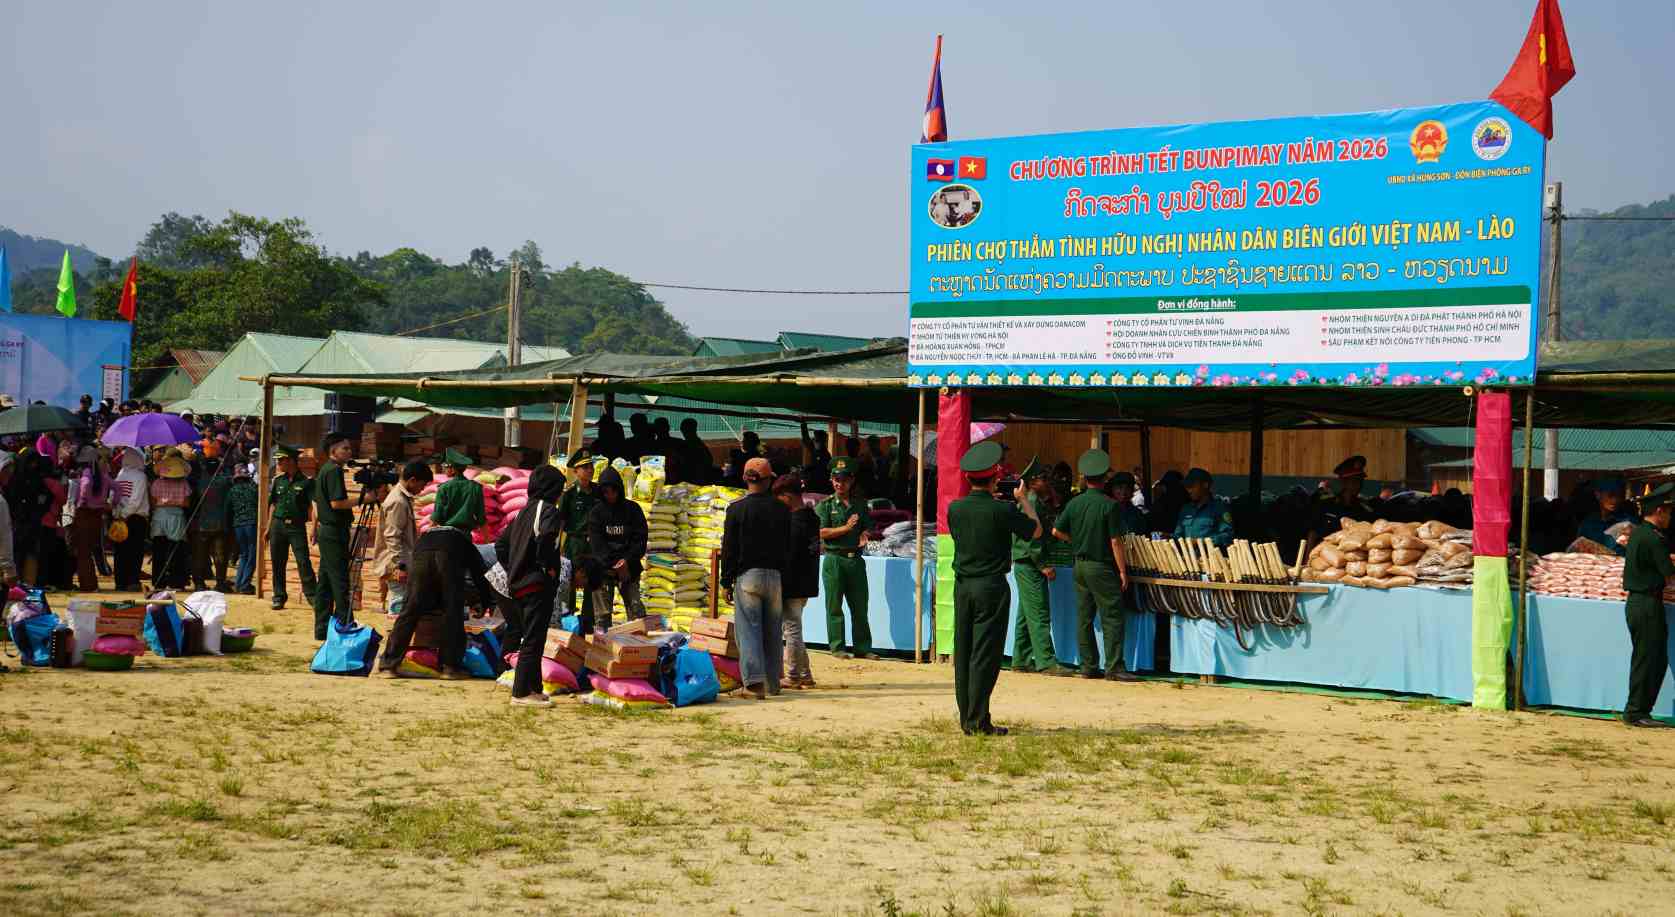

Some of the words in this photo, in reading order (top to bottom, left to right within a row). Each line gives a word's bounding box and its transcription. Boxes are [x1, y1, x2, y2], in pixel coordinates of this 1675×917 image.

[1010, 156, 1085, 181] CHƯƠNG
[1090, 151, 1143, 176] TRÌNH
[1148, 144, 1180, 172] TẾT
[1183, 144, 1281, 170] BUNPIMAY
[1287, 137, 1333, 164] NĂM
[1338, 137, 1389, 160] 2026
[1255, 178, 1321, 208] 2026
[927, 239, 971, 264] PHIÊN
[976, 240, 1006, 265] CHỢ
[1059, 235, 1098, 257] TÌNH
[1101, 232, 1137, 256] HỮU
[1142, 233, 1183, 260] NGHỊ
[1187, 228, 1237, 253] NHÂN
[1241, 227, 1277, 250] DÂN
[1282, 224, 1325, 249] BIÊN
[1329, 221, 1367, 247] GIỚI
[1371, 219, 1412, 251] VIỆT
[1416, 220, 1461, 243] NAM
[1478, 214, 1515, 241] LÀO
[1342, 262, 1380, 281] ລາວ
[1158, 299, 1175, 309] Đơn
[1187, 297, 1210, 310] đồng
[1211, 296, 1236, 308] hành:
[1113, 318, 1131, 327] CÔNG
[1132, 318, 1139, 327] TY
[1140, 317, 1149, 327] CỔ
[1205, 315, 1225, 325] NẴNG
[1329, 313, 1351, 322] NHÓM
[1495, 309, 1506, 319] HÀ
[1508, 309, 1522, 319] NỘI
[1126, 329, 1147, 338] DOANH
[1270, 325, 1290, 336] NẴNG
[1328, 325, 1351, 335] NHÓM
[1455, 321, 1472, 332] PHỐ
[1473, 321, 1484, 331] HỒ
[1485, 321, 1498, 332] CHÍ
[1499, 321, 1520, 331] MINH
[1112, 340, 1131, 349] CÔNG
[1132, 340, 1139, 348] TY
[1168, 340, 1183, 350] DỊCH
[1242, 337, 1263, 348] NẴNG
[1393, 335, 1414, 345] CÔNG
[1415, 335, 1423, 345] TY
[1442, 335, 1468, 344] PHONG
[1474, 335, 1483, 343] TP
[1484, 335, 1502, 343] HCM
